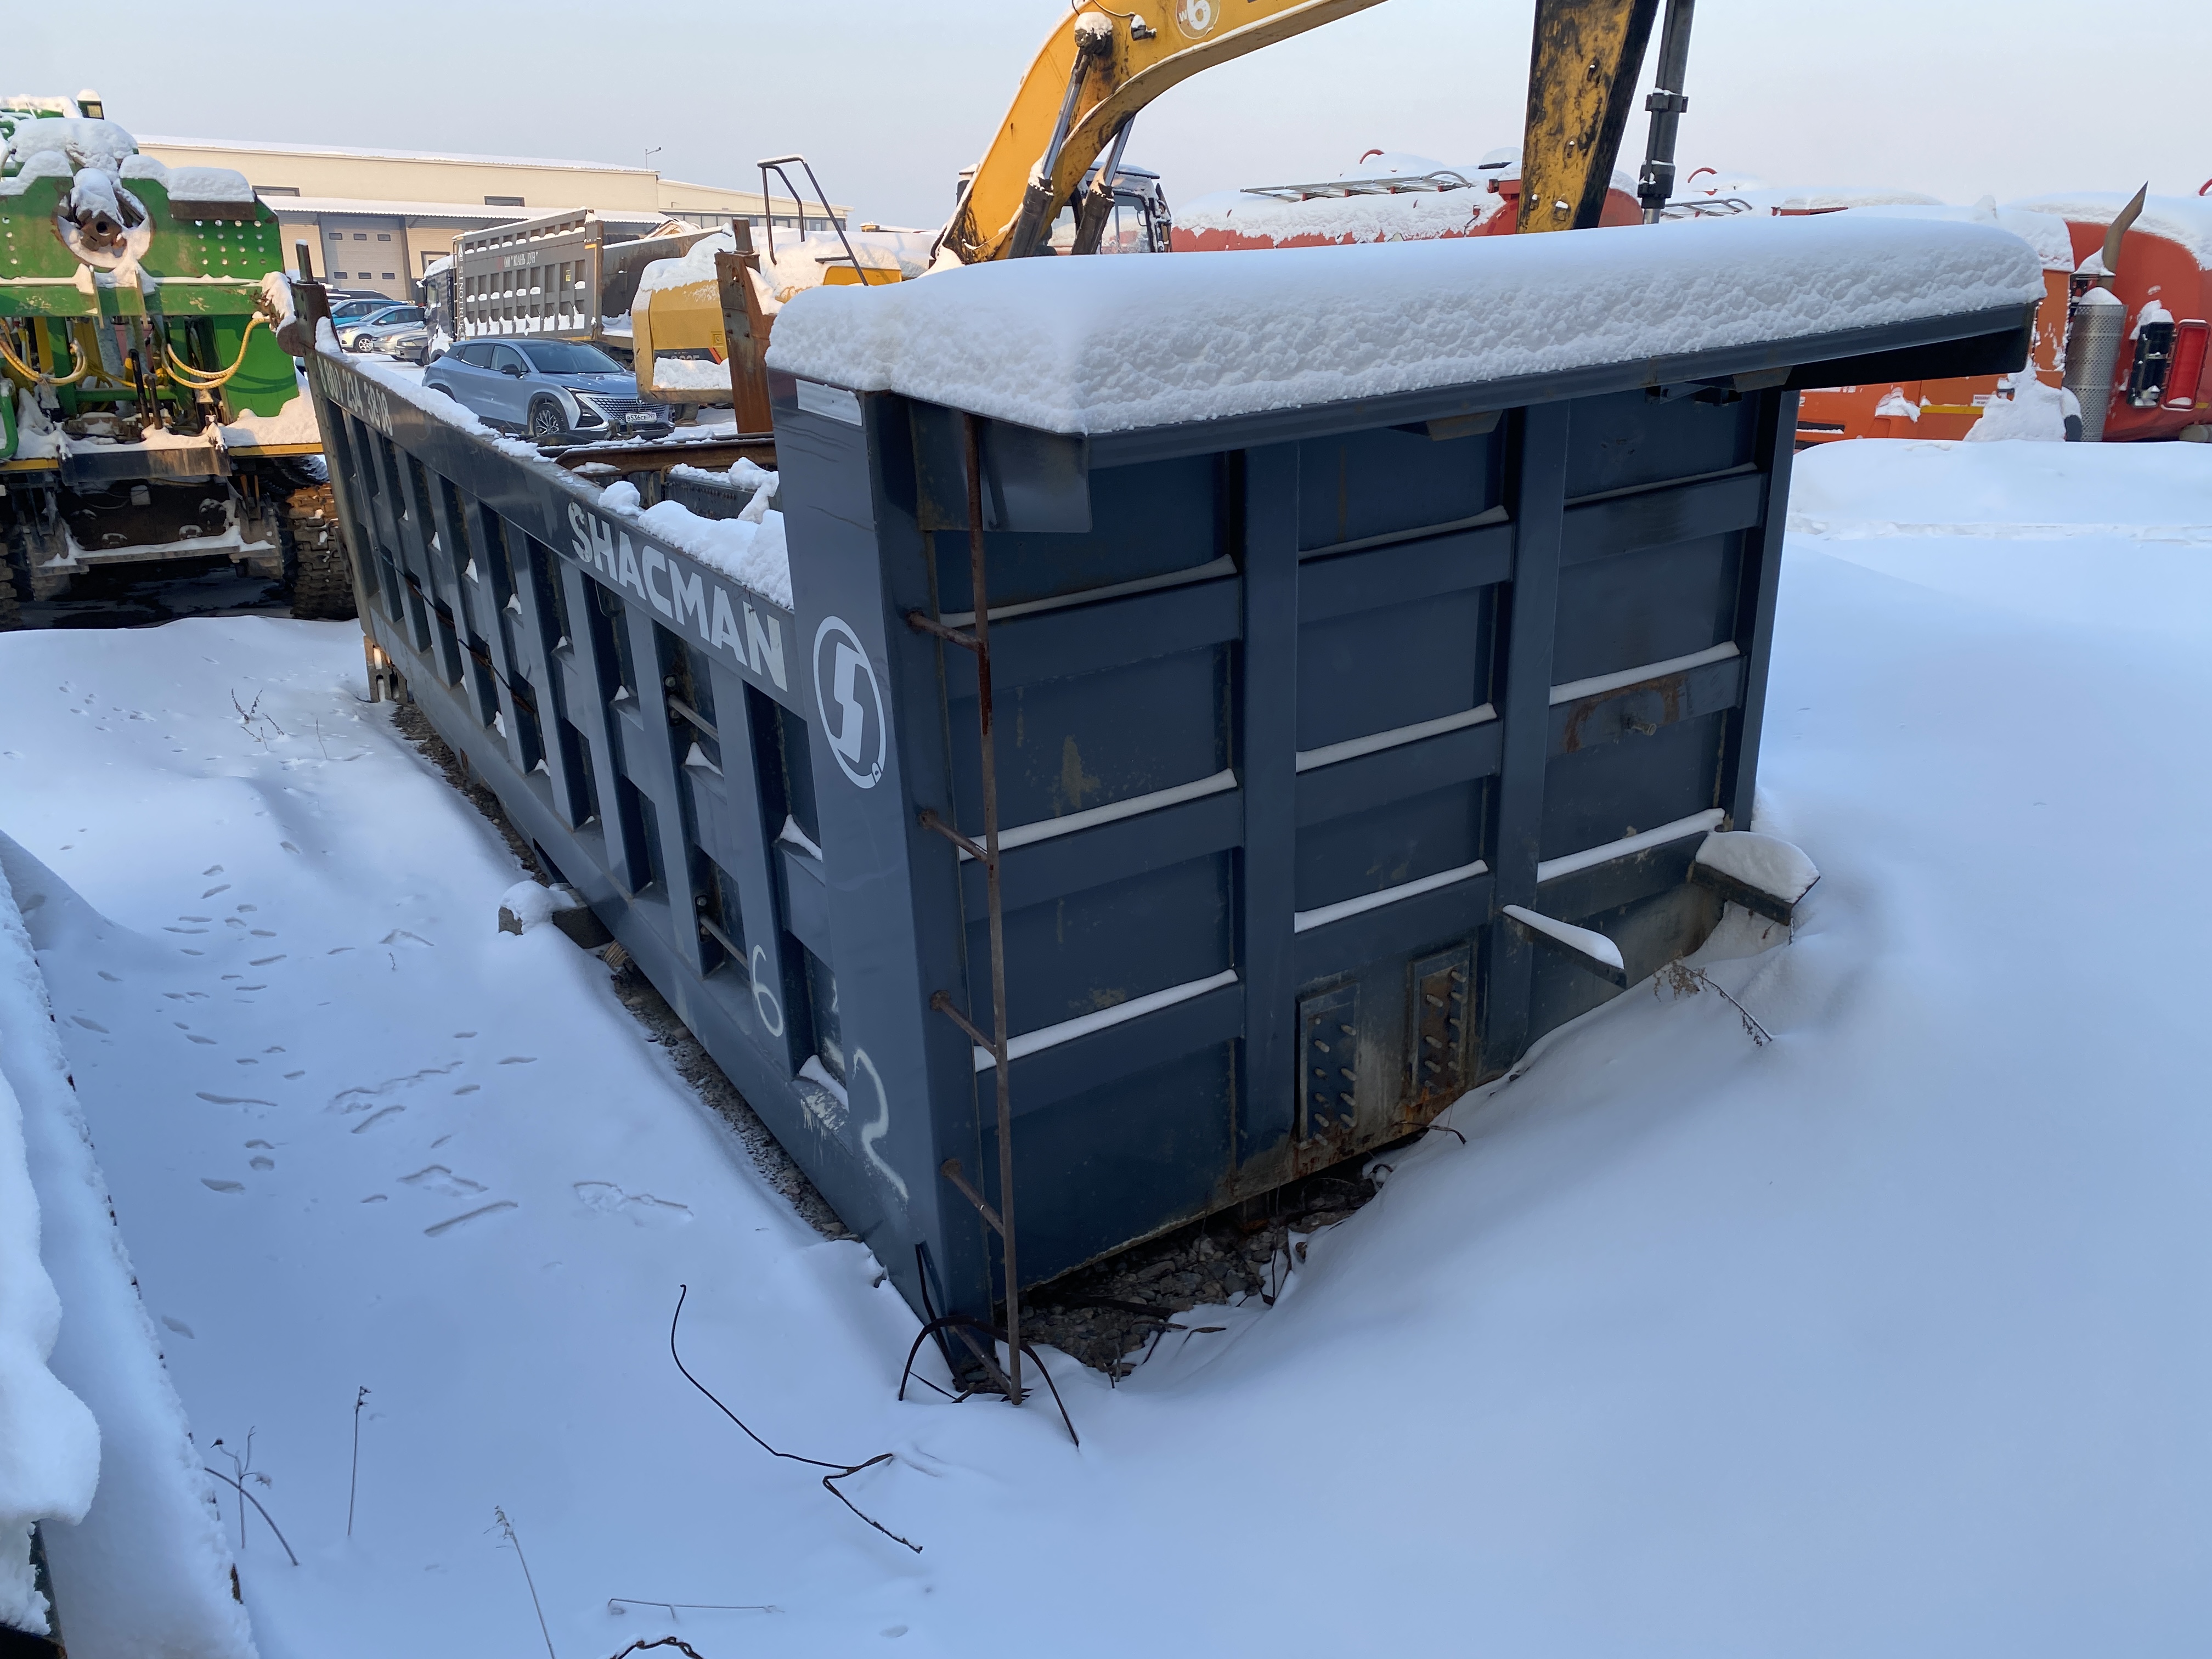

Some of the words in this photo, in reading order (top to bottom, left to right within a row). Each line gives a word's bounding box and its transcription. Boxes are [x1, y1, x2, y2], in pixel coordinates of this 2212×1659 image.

[317, 355, 328, 393] 8
[342, 368, 364, 416] 234
[568, 501, 788, 692] SHACMAN
